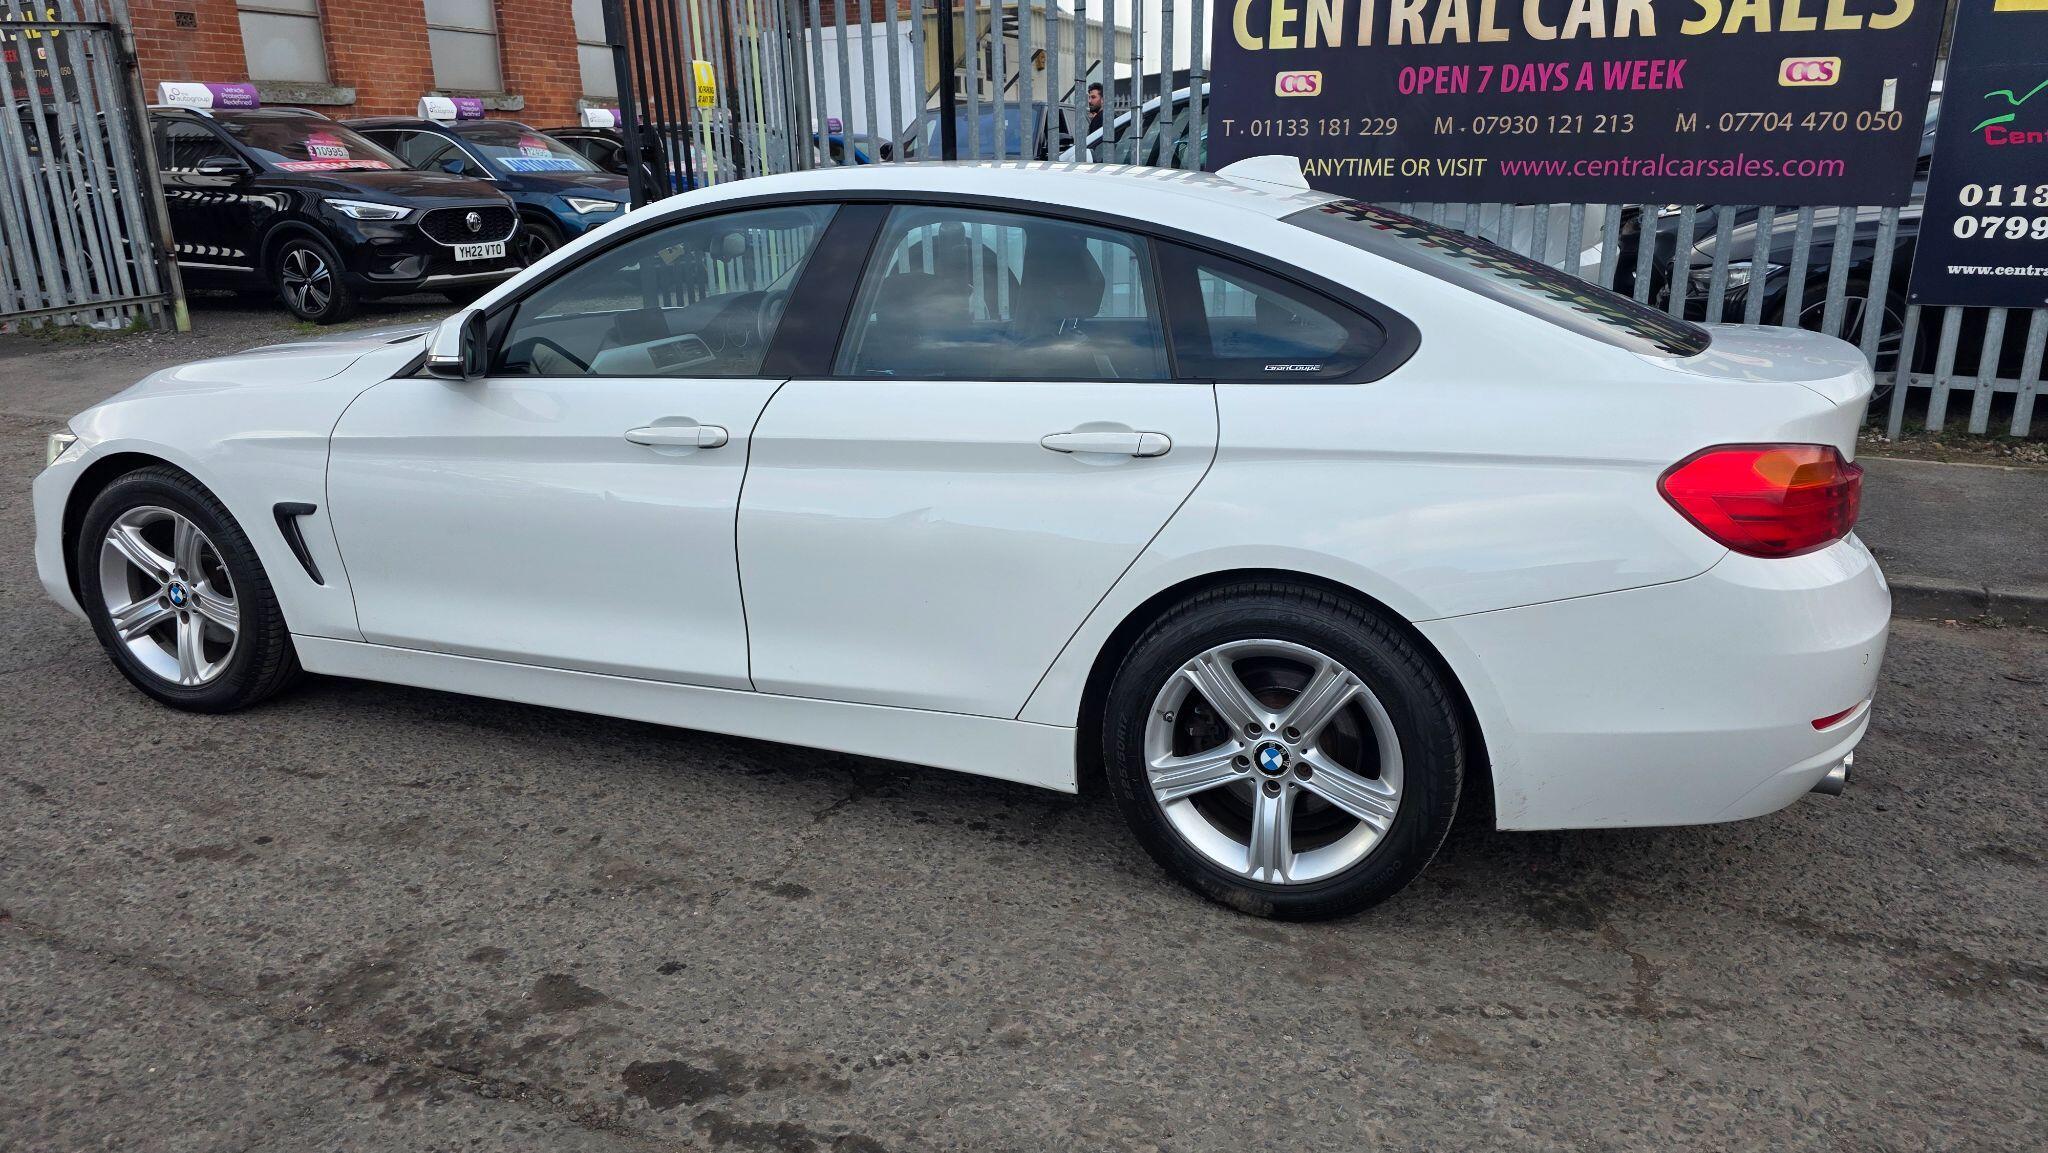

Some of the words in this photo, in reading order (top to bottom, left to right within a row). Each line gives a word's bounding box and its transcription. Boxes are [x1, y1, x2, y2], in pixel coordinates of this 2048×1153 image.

[1398, 65, 1470, 95] OPEN
[1477, 65, 1494, 94] 7
[1500, 62, 1569, 93] DAYS
[1574, 62, 1594, 92] A
[1603, 59, 1688, 90] WEEK
[1785, 61, 1835, 83] CCS
[1280, 75, 1317, 93] CCS
[1250, 118, 1309, 137] 01133
[1318, 118, 1351, 136] 181
[1359, 117, 1398, 136] 229
[1472, 115, 1538, 134] 07930
[1548, 114, 1583, 133] 121
[1593, 113, 1635, 133] 213
[1719, 112, 1794, 132] 07704
[1801, 111, 1848, 131] 470
[1855, 110, 1903, 131] 050
[1303, 158, 1395, 177] ANYTIME
[1401, 158, 1430, 177] OR
[1436, 158, 1488, 176] VISIT
[1500, 153, 1846, 177] www.centralcarsales.com
[459, 246, 483, 258] YH22
[485, 244, 502, 256] VTO
